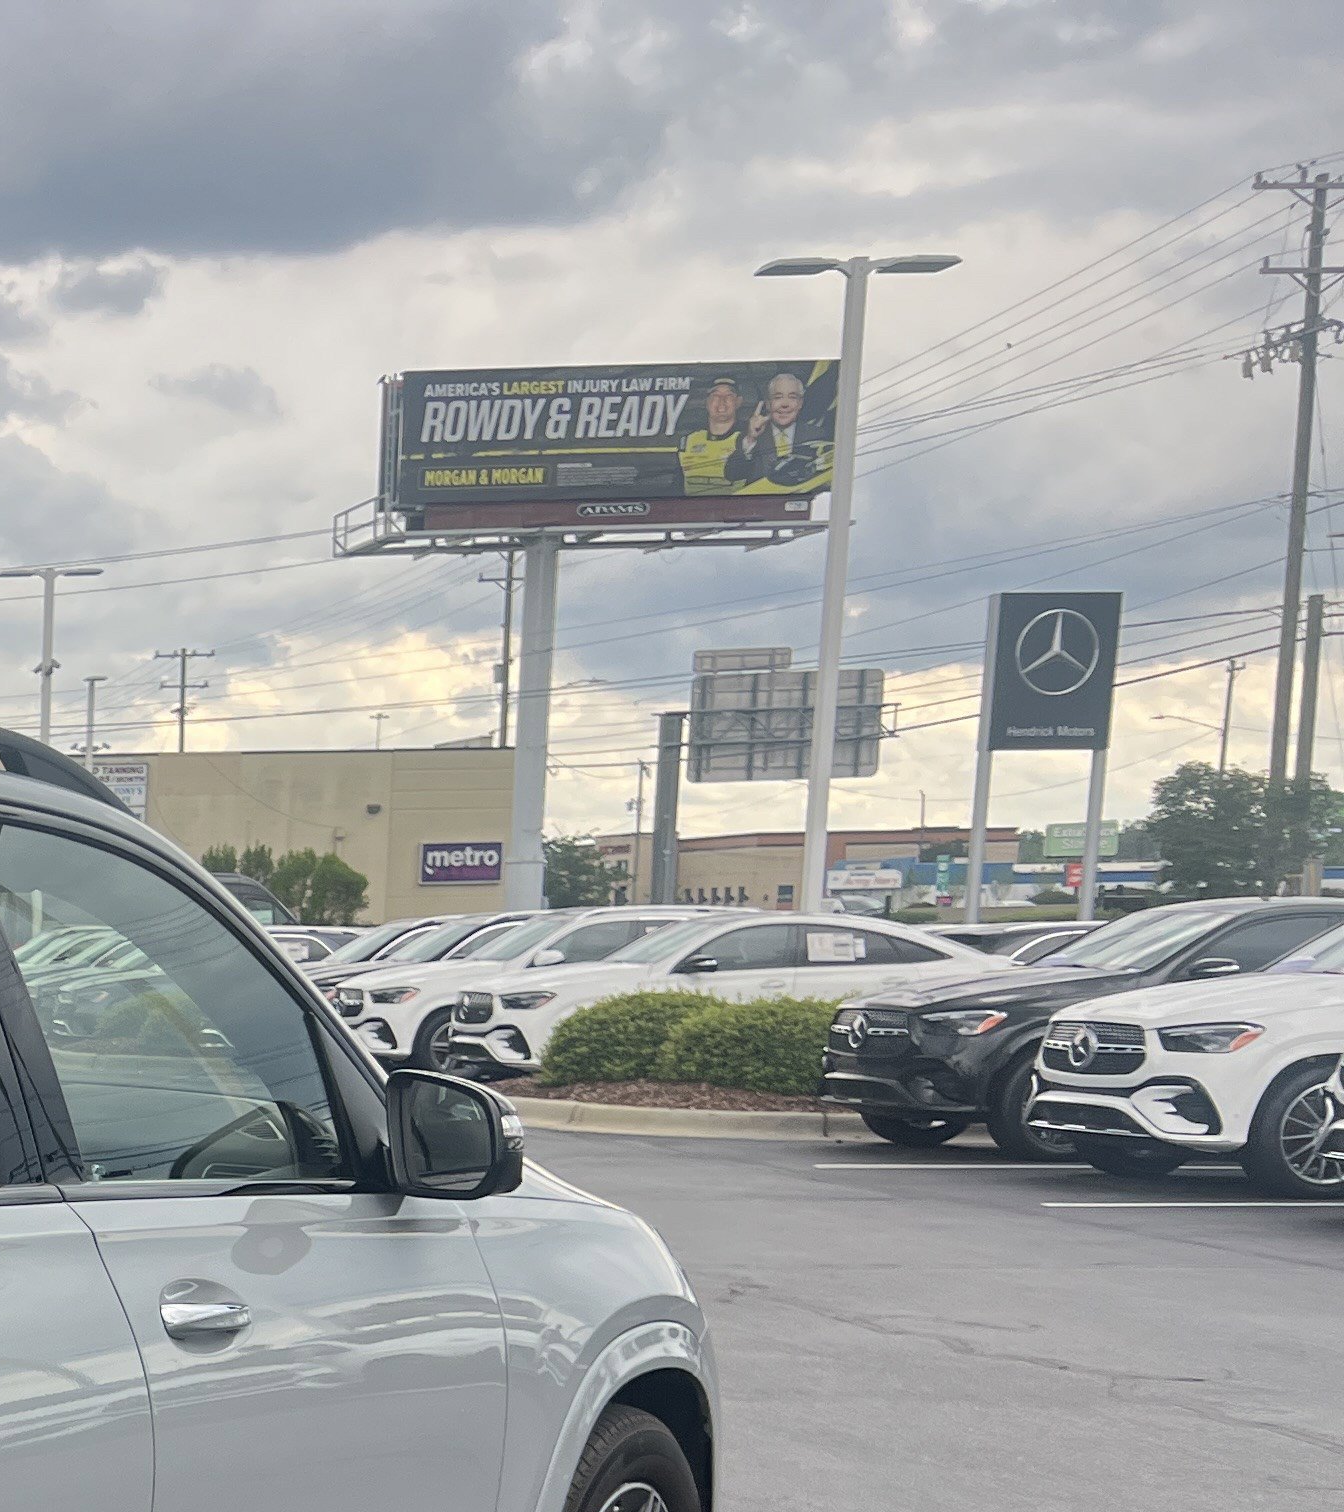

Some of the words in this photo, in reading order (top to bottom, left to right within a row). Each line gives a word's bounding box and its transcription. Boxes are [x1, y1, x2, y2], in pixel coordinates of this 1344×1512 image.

[424, 383, 500, 397] AMERICA'S
[502, 381, 565, 395] LARGEST
[567, 380, 620, 394] INJURY
[621, 378, 653, 392] LAW
[655, 377, 691, 391] FIRM
[420, 399, 546, 443] ROWDY
[545, 397, 571, 440] &
[574, 394, 689, 439] READY
[424, 469, 477, 487] MORGAN
[479, 469, 488, 486] &
[491, 467, 545, 486] MORGAN
[426, 846, 500, 868] metro
